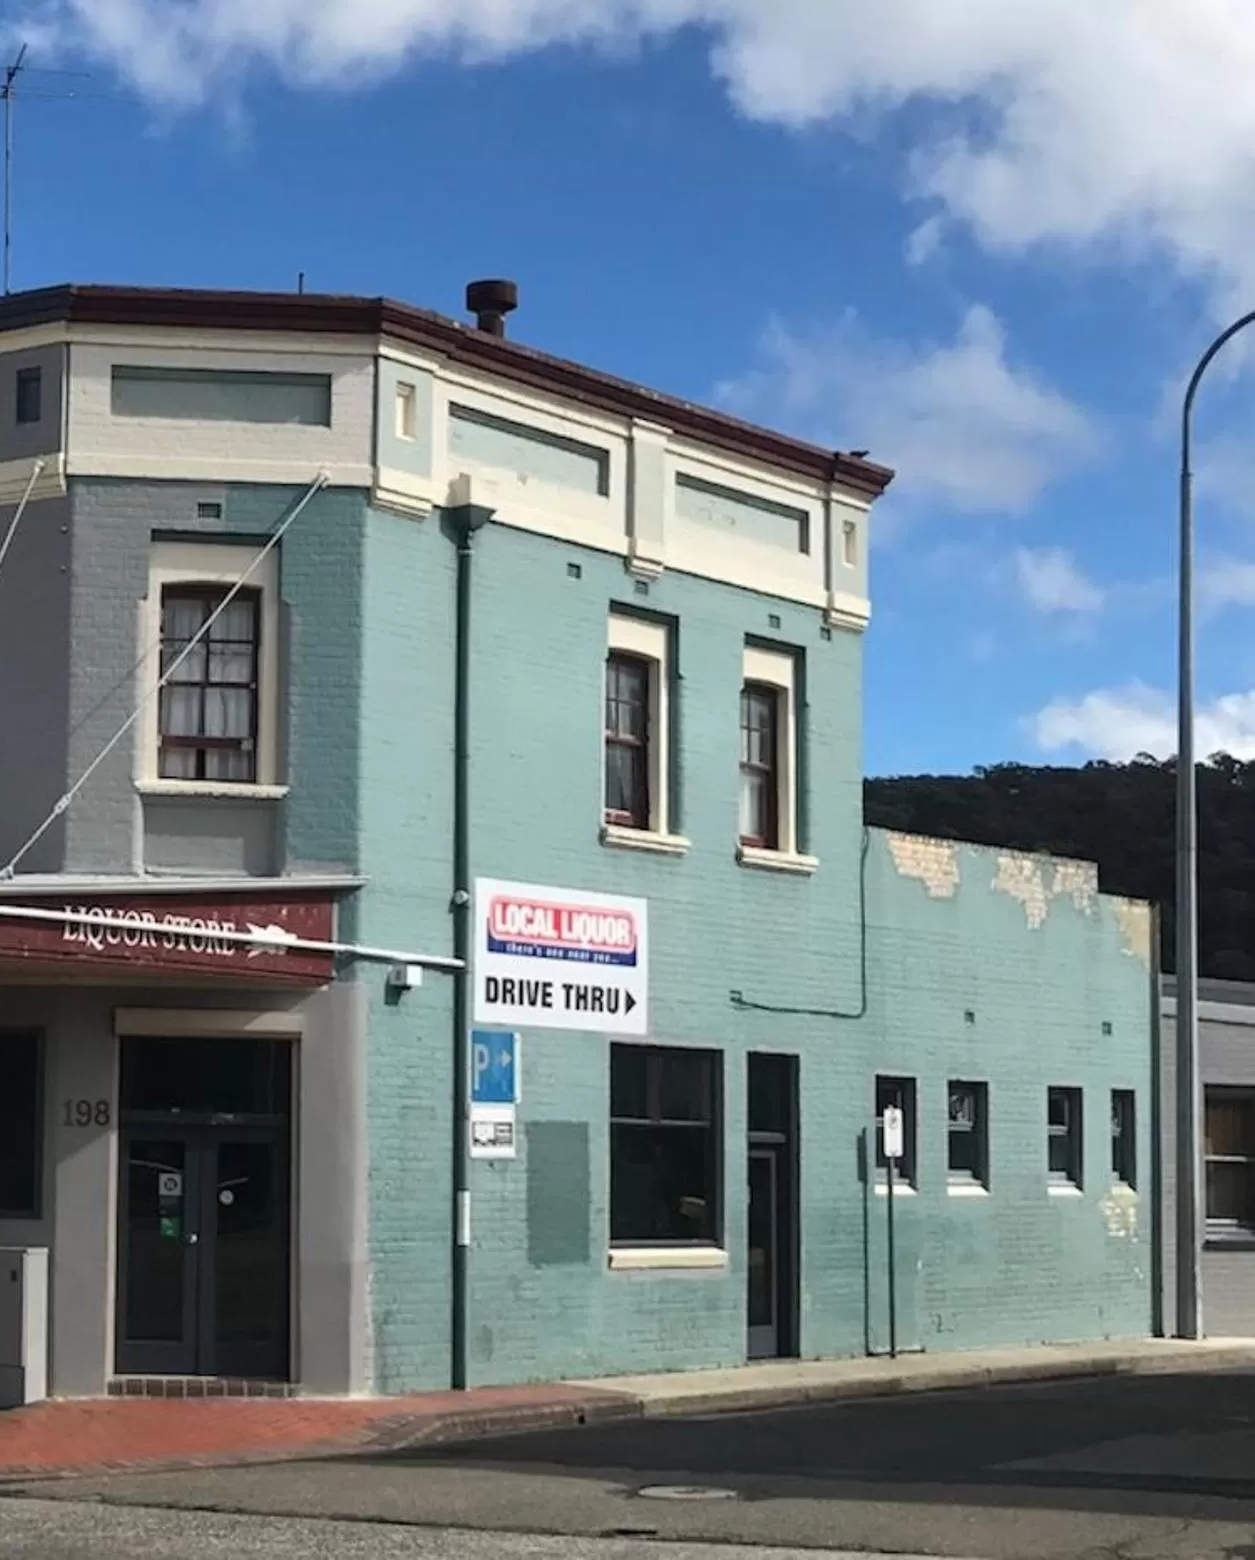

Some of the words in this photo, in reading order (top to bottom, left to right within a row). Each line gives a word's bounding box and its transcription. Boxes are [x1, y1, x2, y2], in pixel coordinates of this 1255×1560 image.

[62, 905, 157, 951] LIQUOR
[163, 913, 236, 957] STORE
[495, 902, 559, 938] LOCAL
[561, 909, 632, 947] LIQUOR
[485, 976, 553, 1008] DRIVE
[562, 983, 620, 1014] THRU
[473, 1043, 490, 1091] P
[63, 1099, 111, 1128] 198
